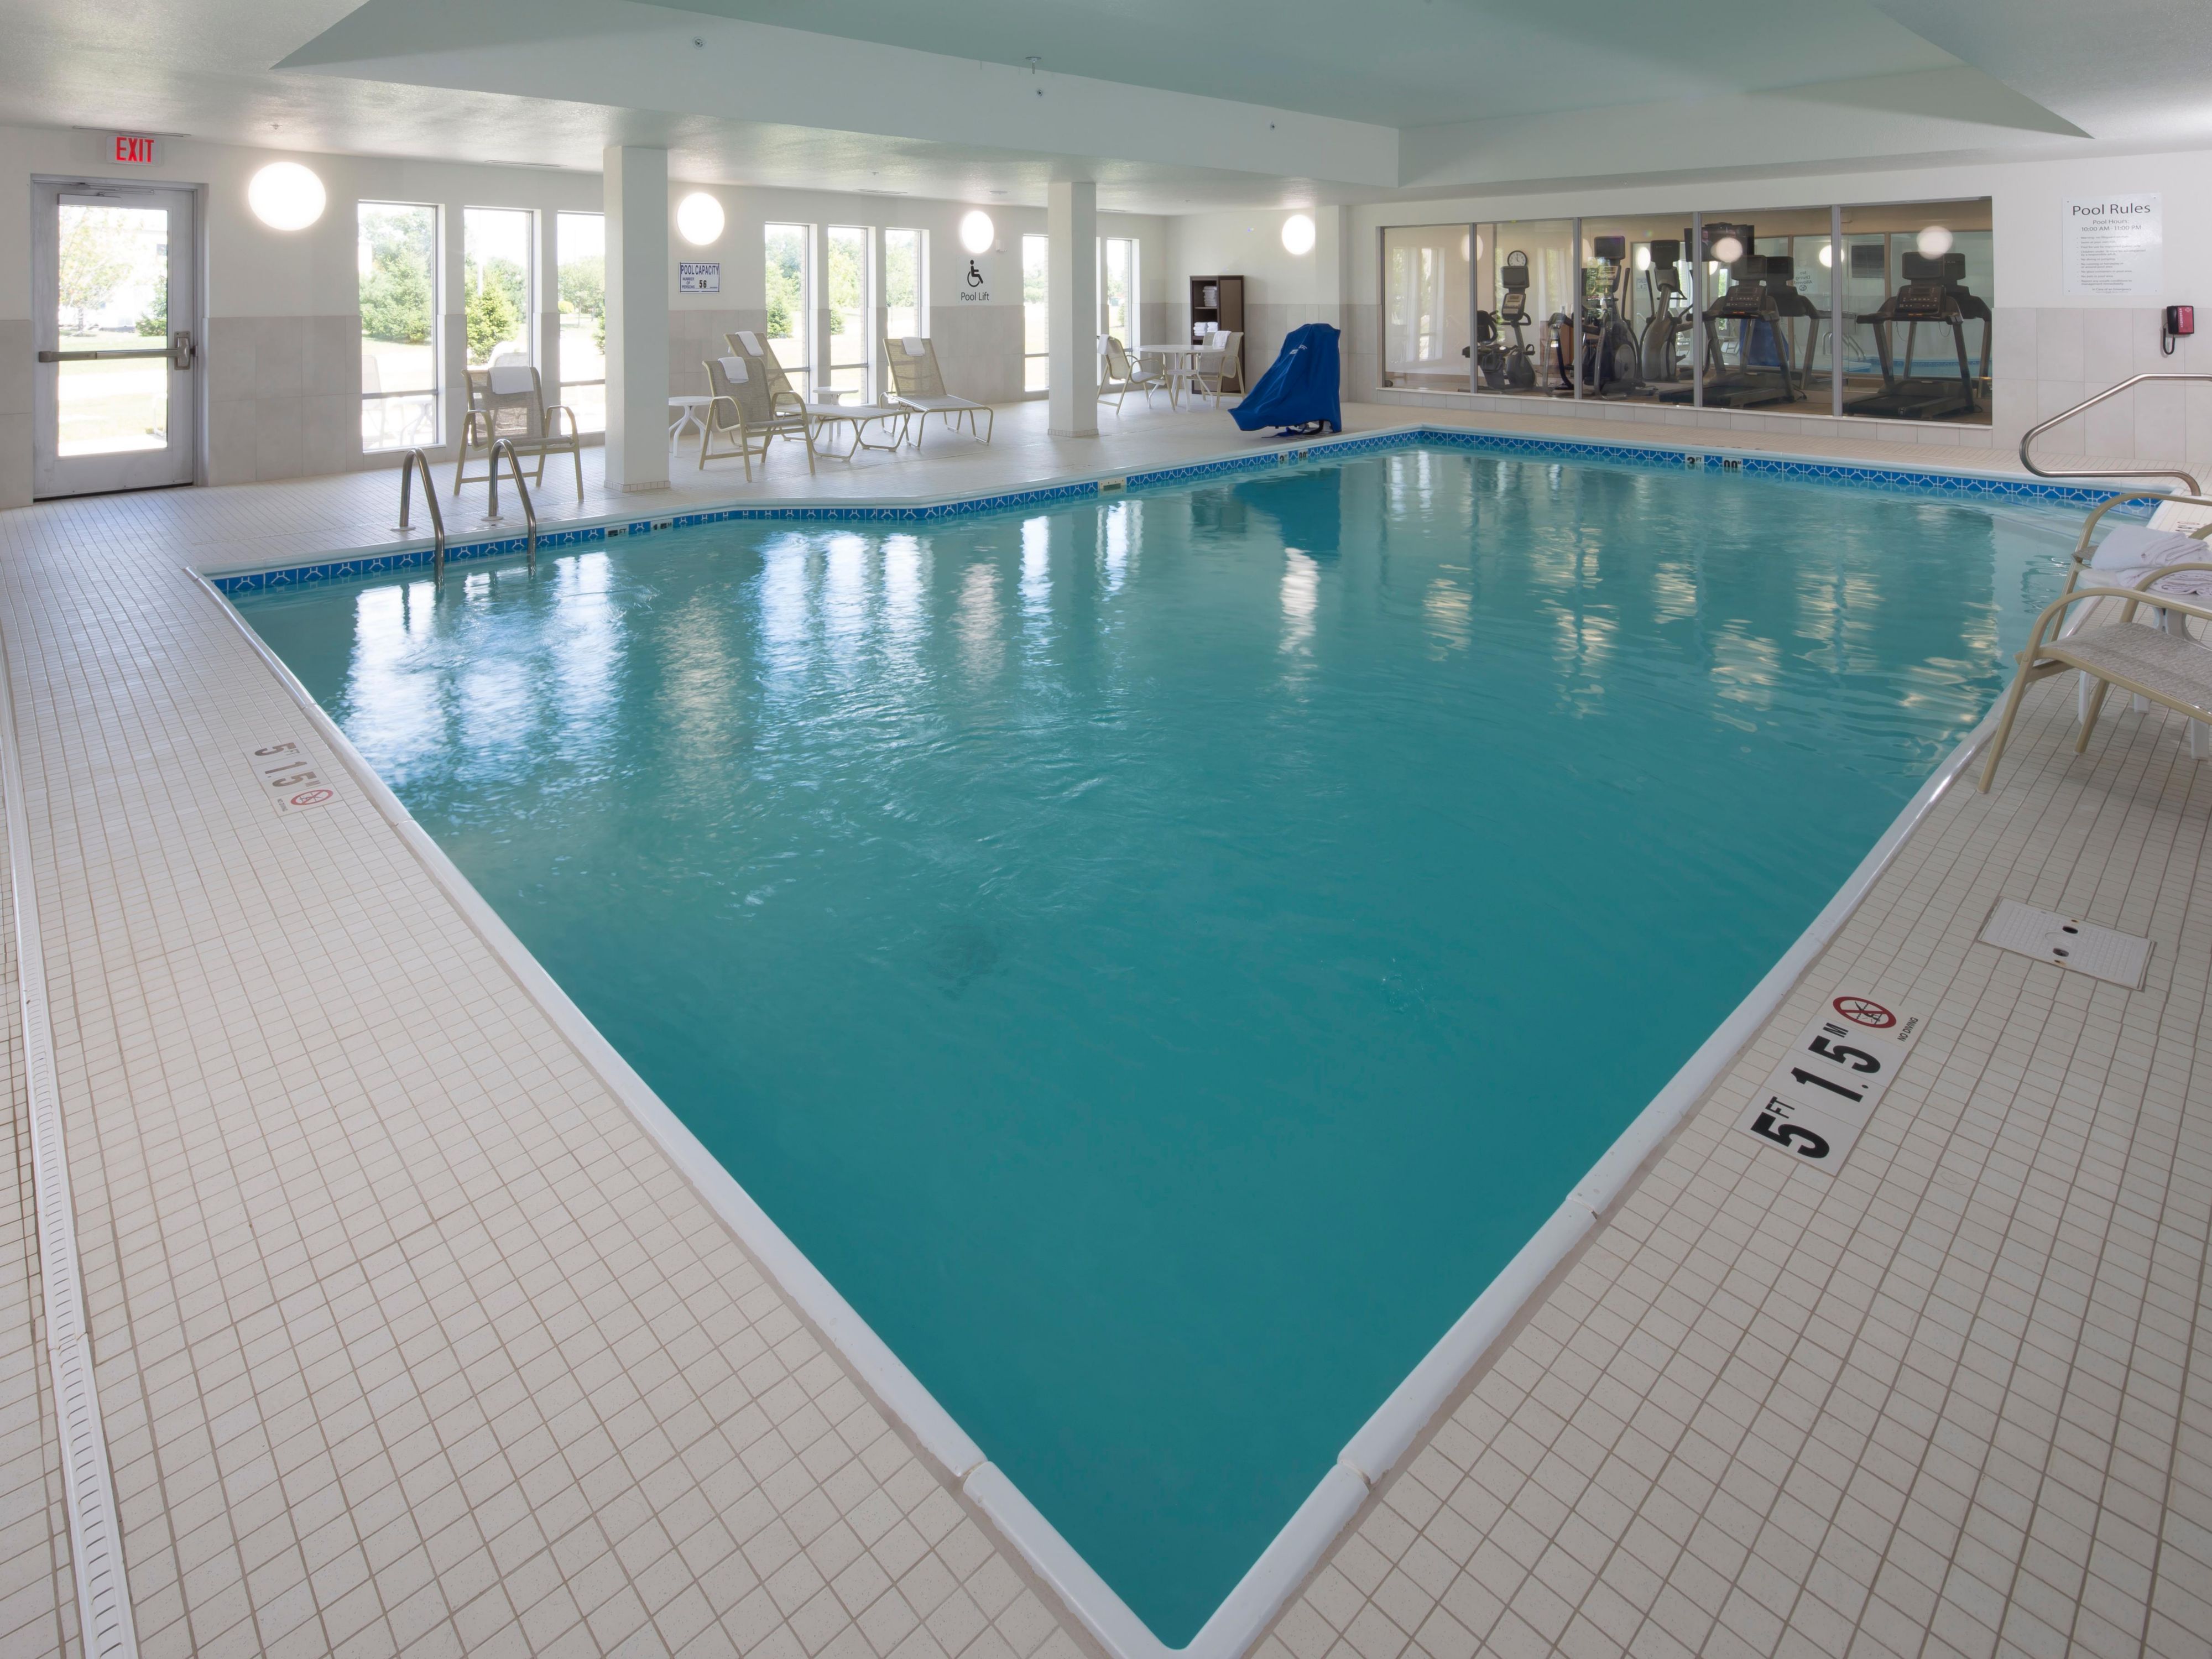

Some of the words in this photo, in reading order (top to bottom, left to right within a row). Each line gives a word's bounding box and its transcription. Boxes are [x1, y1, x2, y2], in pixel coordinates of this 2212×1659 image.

[116, 137, 154, 163] EXIT
[2073, 204, 2104, 216] Pool
[2110, 203, 2151, 214] Rules
[681, 265, 695, 274] POOL
[695, 265, 719, 275] CAPACITY
[699, 280, 707, 288] 56
[961, 292, 976, 301] Pool
[978, 291, 989, 301] Lift
[1897, 1032, 1908, 1042] NO
[1903, 1017, 1918, 1034] DIVING
[1765, 1096, 1795, 1119] FT
[1750, 1112, 1830, 1159] 5
